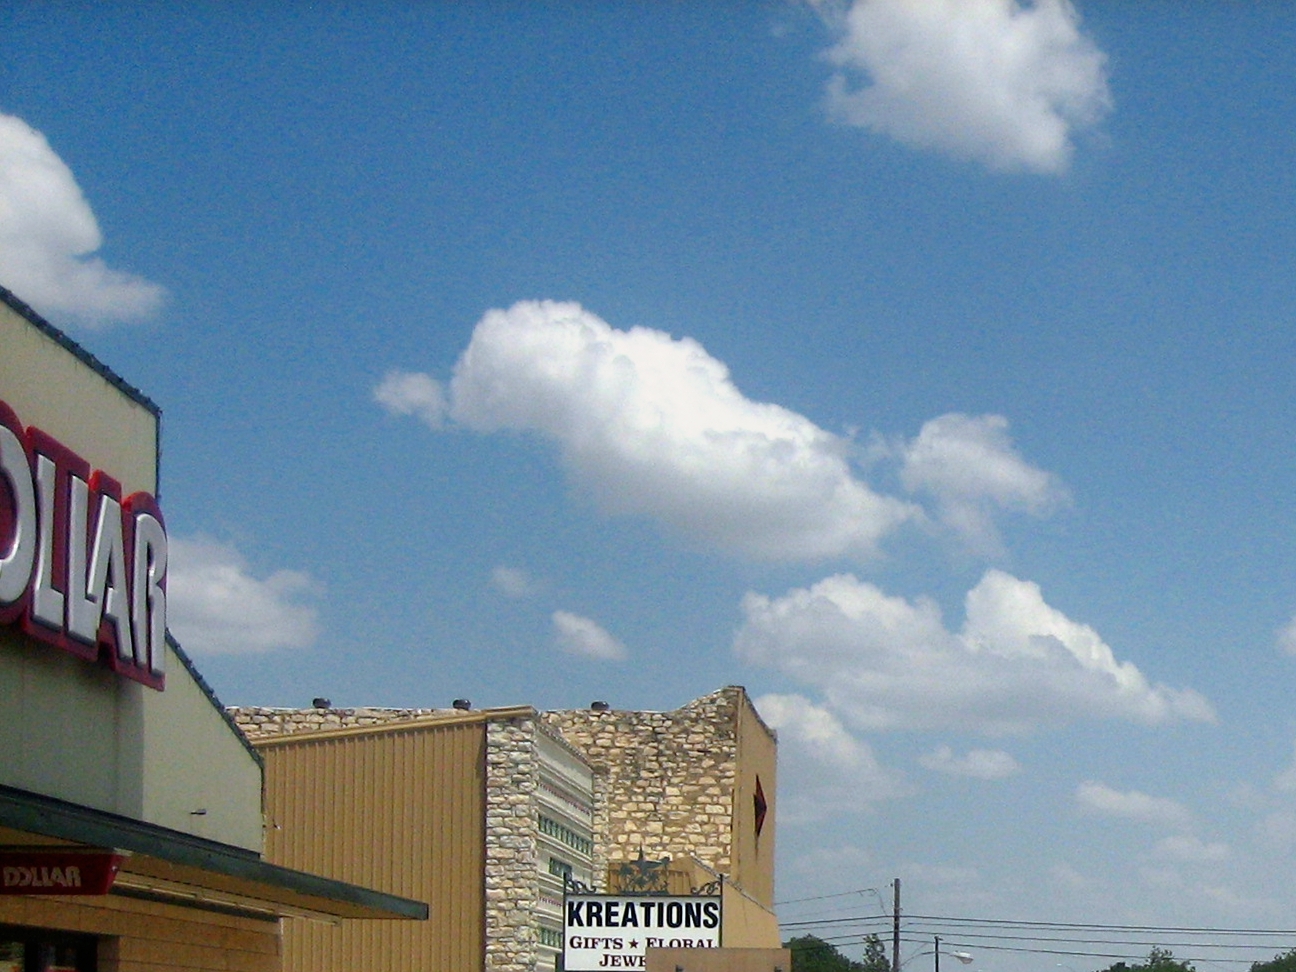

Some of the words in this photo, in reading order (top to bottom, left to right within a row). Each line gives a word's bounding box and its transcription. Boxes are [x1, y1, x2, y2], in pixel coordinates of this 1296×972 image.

[3, 866, 82, 887] DOLLAR
[567, 901, 719, 928] KREATIONS
[569, 936, 623, 949] GIFTS
[645, 937, 717, 948] FLORAL
